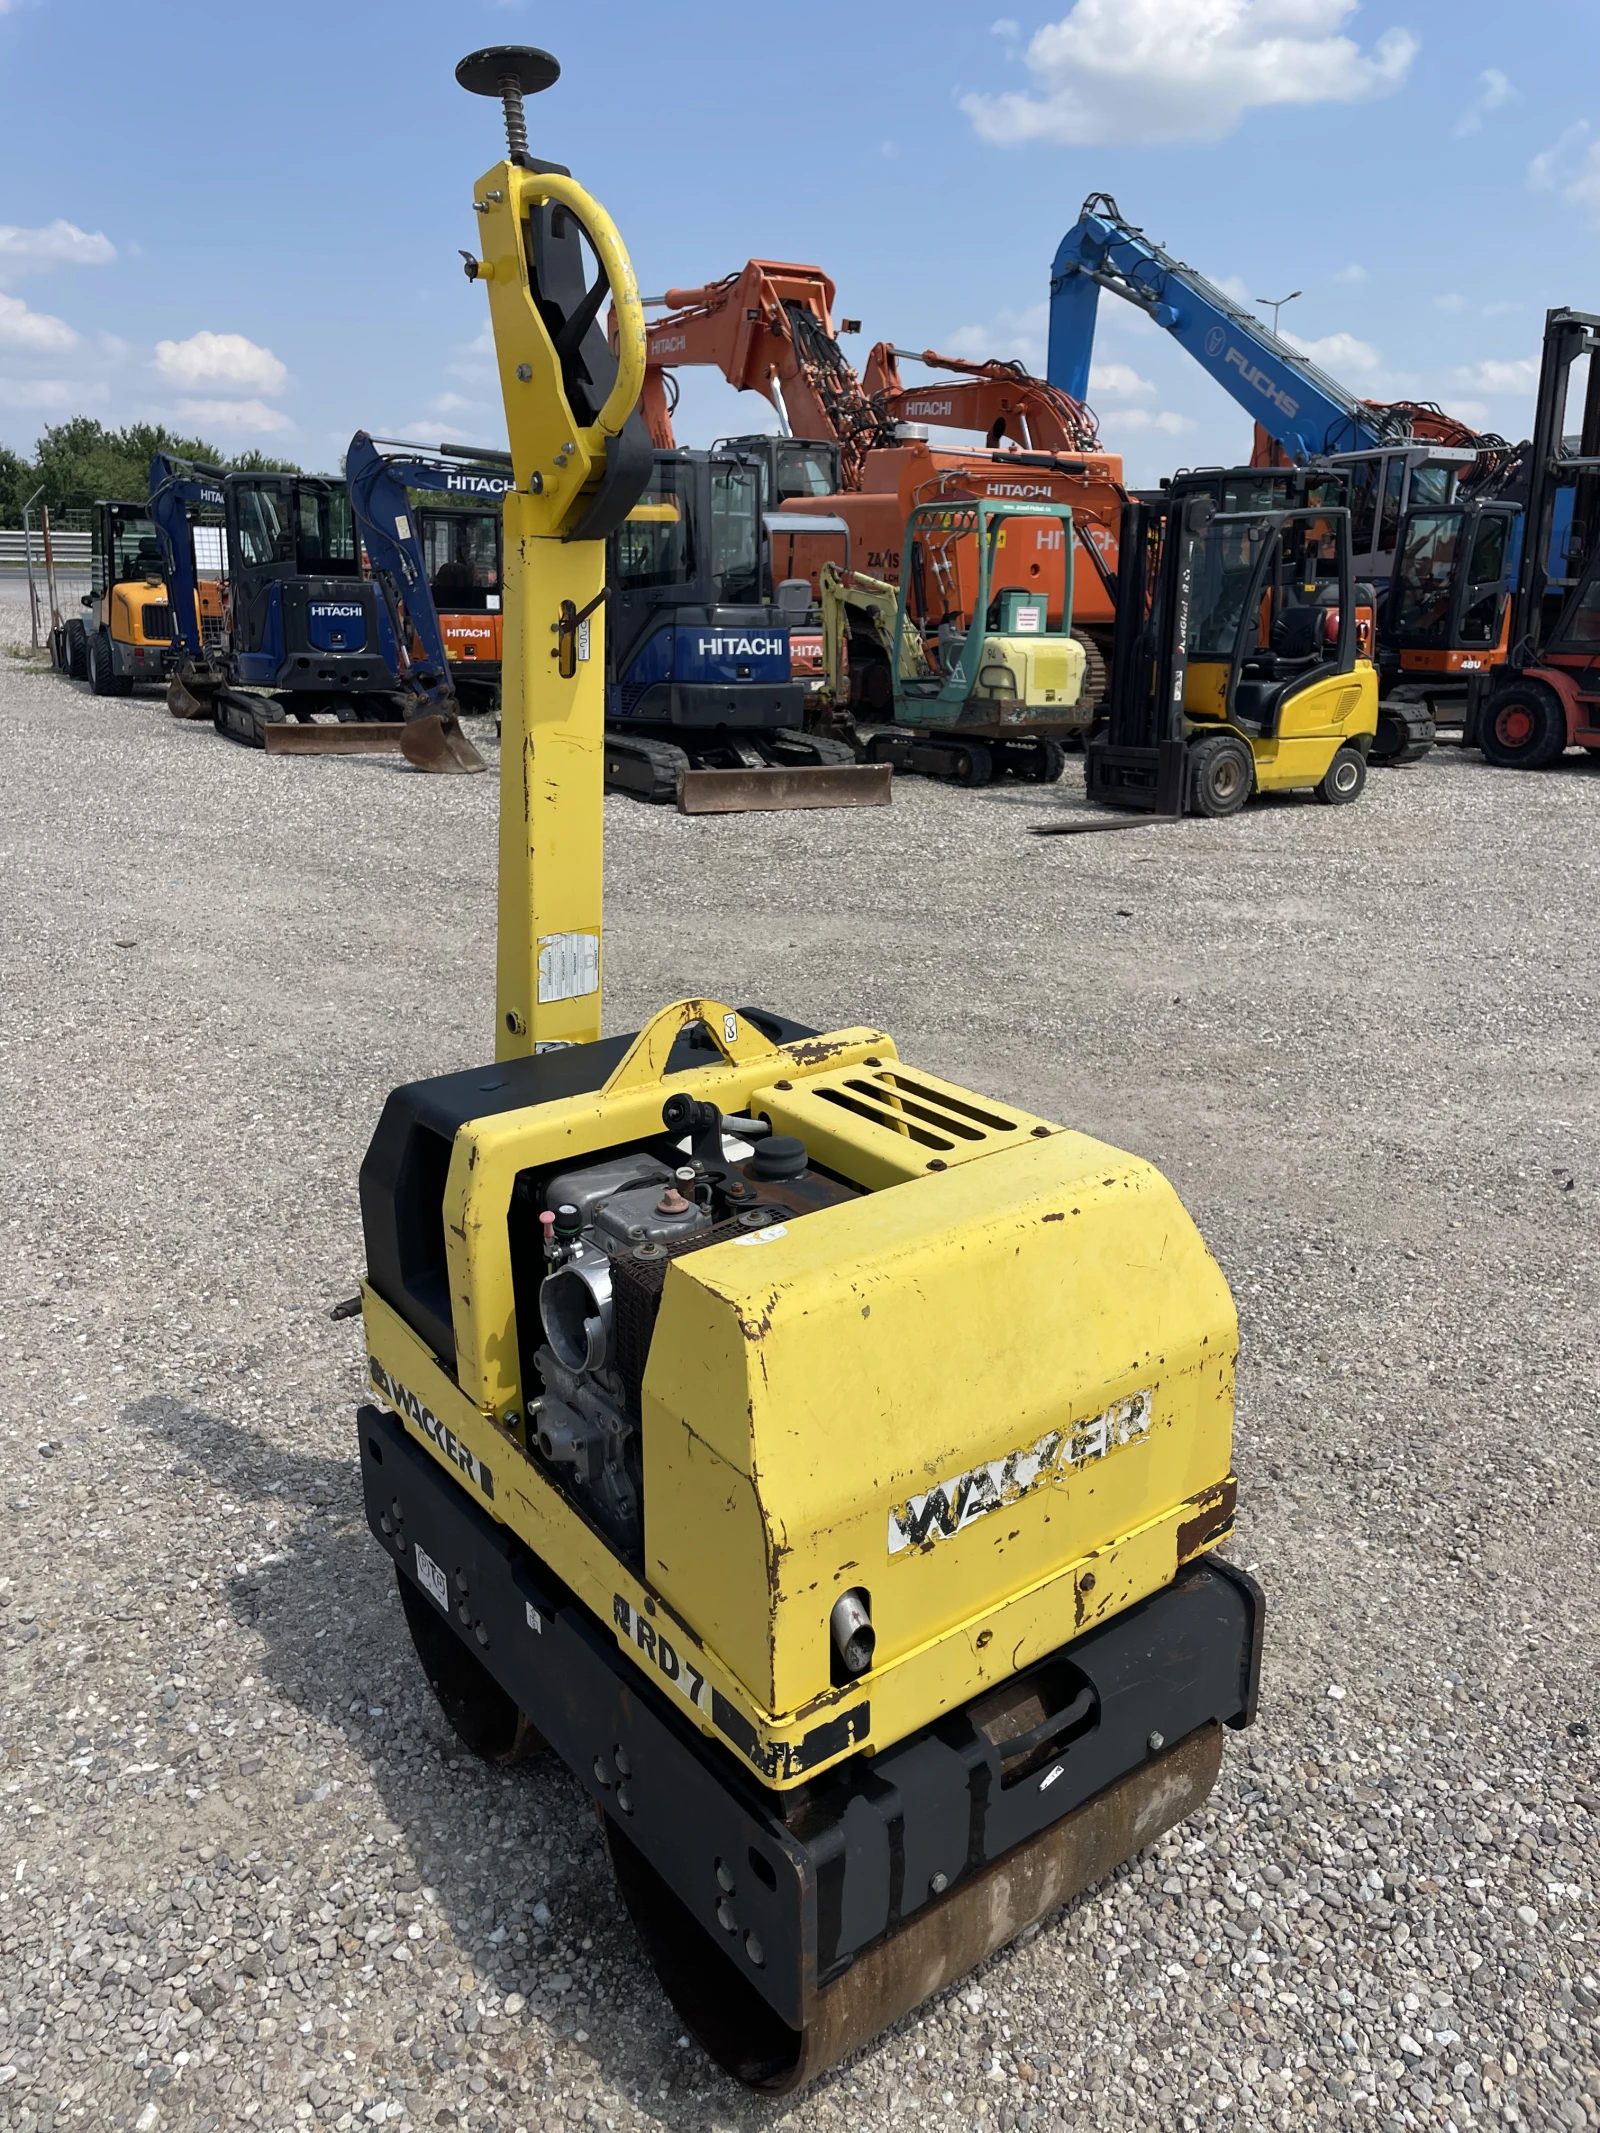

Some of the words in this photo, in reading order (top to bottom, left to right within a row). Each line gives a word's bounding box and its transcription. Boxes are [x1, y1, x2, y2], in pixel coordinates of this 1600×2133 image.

[652, 336, 686, 355] HITACHI
[1225, 347, 1299, 418] FUCHS
[906, 401, 952, 415] HITACHI
[986, 483, 1052, 497] HITACHI
[867, 549, 900, 568] ZAXIS
[311, 606, 362, 617] HITACHI
[446, 628, 490, 638] HITACHI
[698, 638, 782, 656] HITACHI
[987, 648, 997, 660] 94
[1460, 660, 1481, 669] 48U
[388, 1376, 477, 1485] WACKER
